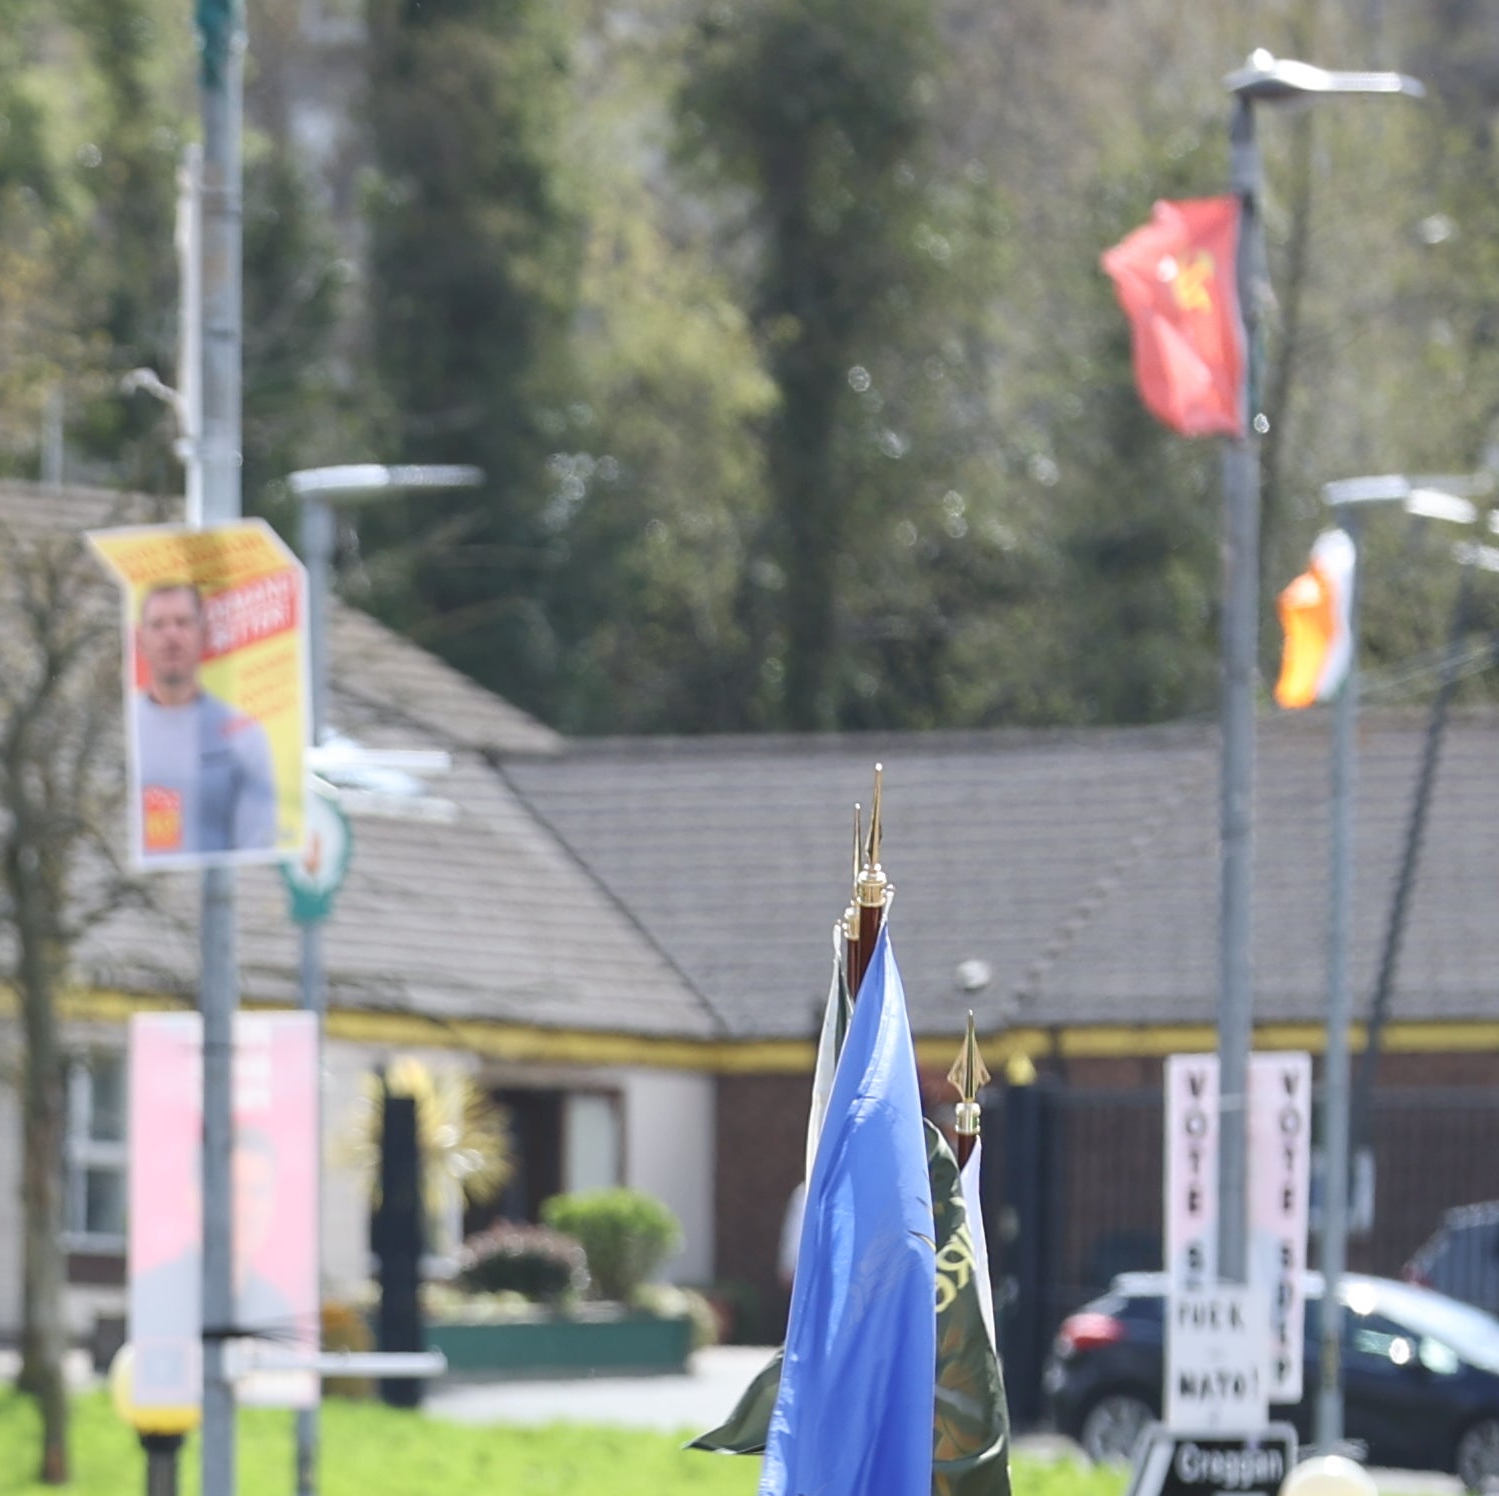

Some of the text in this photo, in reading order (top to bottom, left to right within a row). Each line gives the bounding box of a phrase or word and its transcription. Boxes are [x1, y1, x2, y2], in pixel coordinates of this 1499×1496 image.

[1183, 1070, 1208, 1216] VOTE
[1279, 1067, 1302, 1214] VOTE
[1175, 1441, 1284, 1490] Creggan
